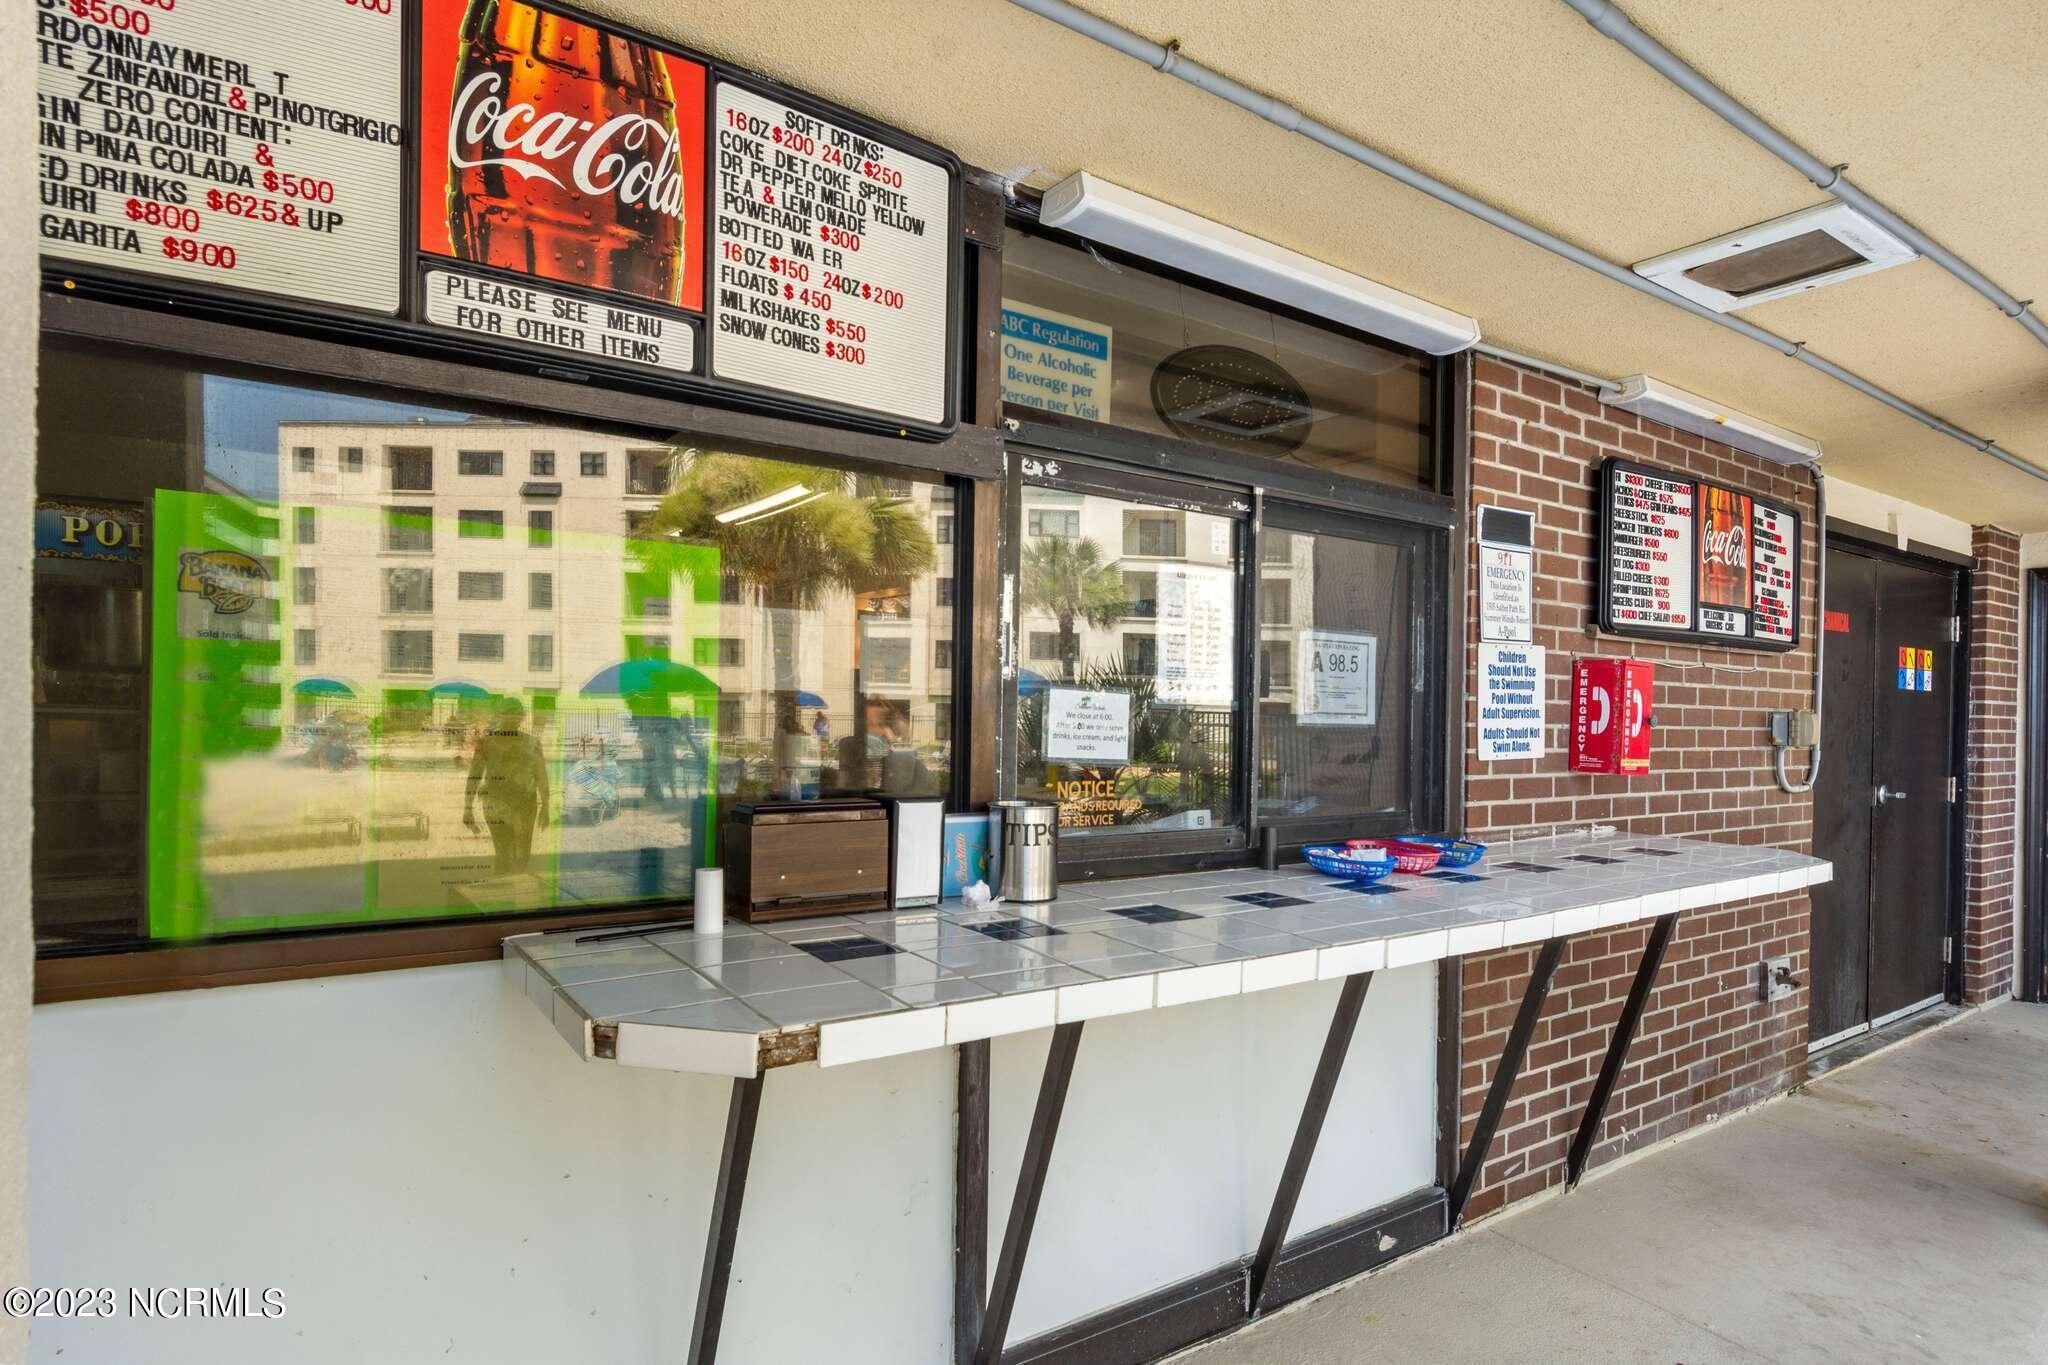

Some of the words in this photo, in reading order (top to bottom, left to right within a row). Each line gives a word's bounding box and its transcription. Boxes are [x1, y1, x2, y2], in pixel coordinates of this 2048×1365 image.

[37, 38, 74, 70] TE
[87, 51, 227, 106] ZINFANDEL
[77, 75, 154, 115] ZERO
[165, 98, 291, 145] CONTENT:
[785, 111, 824, 140] SOFT
[104, 109, 227, 157] DAIQUIRI
[255, 143, 275, 168] &
[450, 71, 684, 220] Coca-Cola
[76, 129, 141, 165] PINA
[151, 146, 254, 189] COLADA
[262, 170, 334, 204] $500
[720, 130, 764, 162] COKE
[859, 181, 908, 213] SPRITE
[40, 181, 96, 214] UIRI
[125, 198, 200, 233] $800
[81, 162, 187, 204] DRINKS
[308, 208, 343, 233] UP
[720, 170, 754, 199] TEA
[763, 186, 775, 205] &
[781, 192, 866, 236] LEMONADE
[721, 150, 743, 174] DR
[751, 161, 815, 200] PEPPER
[820, 186, 866, 216] MELLO
[873, 204, 925, 236] YELLOW
[40, 214, 142, 253] GARITA
[162, 236, 236, 269] $900
[719, 215, 783, 250] BOTTED
[724, 192, 811, 237] POWERADE
[820, 225, 860, 252] $300
[721, 264, 778, 296] FLOATS
[446, 275, 537, 313] PLEASE
[552, 298, 589, 324] SEE
[607, 309, 662, 338] MENU
[720, 288, 820, 331] MILKSHAKES
[825, 318, 866, 343] $550
[456, 305, 502, 333] FOR
[516, 318, 584, 349] OTHER
[601, 334, 660, 364] ITEMS
[720, 313, 767, 341] SNOW
[771, 326, 820, 354] CONES
[825, 341, 866, 366] $300
[1000, 314, 1028, 334] ABC
[1032, 322, 1100, 353] Regulation
[1004, 344, 1032, 363] One
[1038, 352, 1096, 379] Alcoholic
[1007, 365, 1068, 394] Beverage
[1071, 384, 1093, 398] per
[1000, 386, 1043, 408] Person
[1047, 399, 1068, 412] per
[1073, 401, 1100, 420] Visit
[1497, 553, 1512, 566] 911
[1702, 520, 1746, 568] Coca-Cola
[1487, 567, 1525, 581] EMERGENCY
[1311, 651, 1324, 672] A
[1328, 653, 1359, 673] 98.5
[1488, 664, 1511, 676] Should
[1512, 666, 1523, 676] Not
[1524, 666, 1536, 677] Use
[1499, 651, 1526, 663] Children
[1489, 678, 1500, 689] the
[1502, 678, 1535, 691] Swimming
[1492, 693, 1506, 704] Pool
[1507, 693, 1533, 704] Without
[1483, 708, 1500, 719] Adult
[1501, 708, 1540, 720] Supervision.
[1578, 669, 1589, 752] EMERGENCY
[1624, 670, 1633, 755] EMERGENCY
[1484, 728, 1505, 739] Adults
[1506, 728, 1528, 739] Should
[1530, 727, 1540, 738] Not
[1493, 742, 1511, 753] Swim
[1512, 741, 1531, 752] Alone.
[1057, 780, 1115, 799] NOTICE
[1074, 814, 1114, 826] SERVICE
